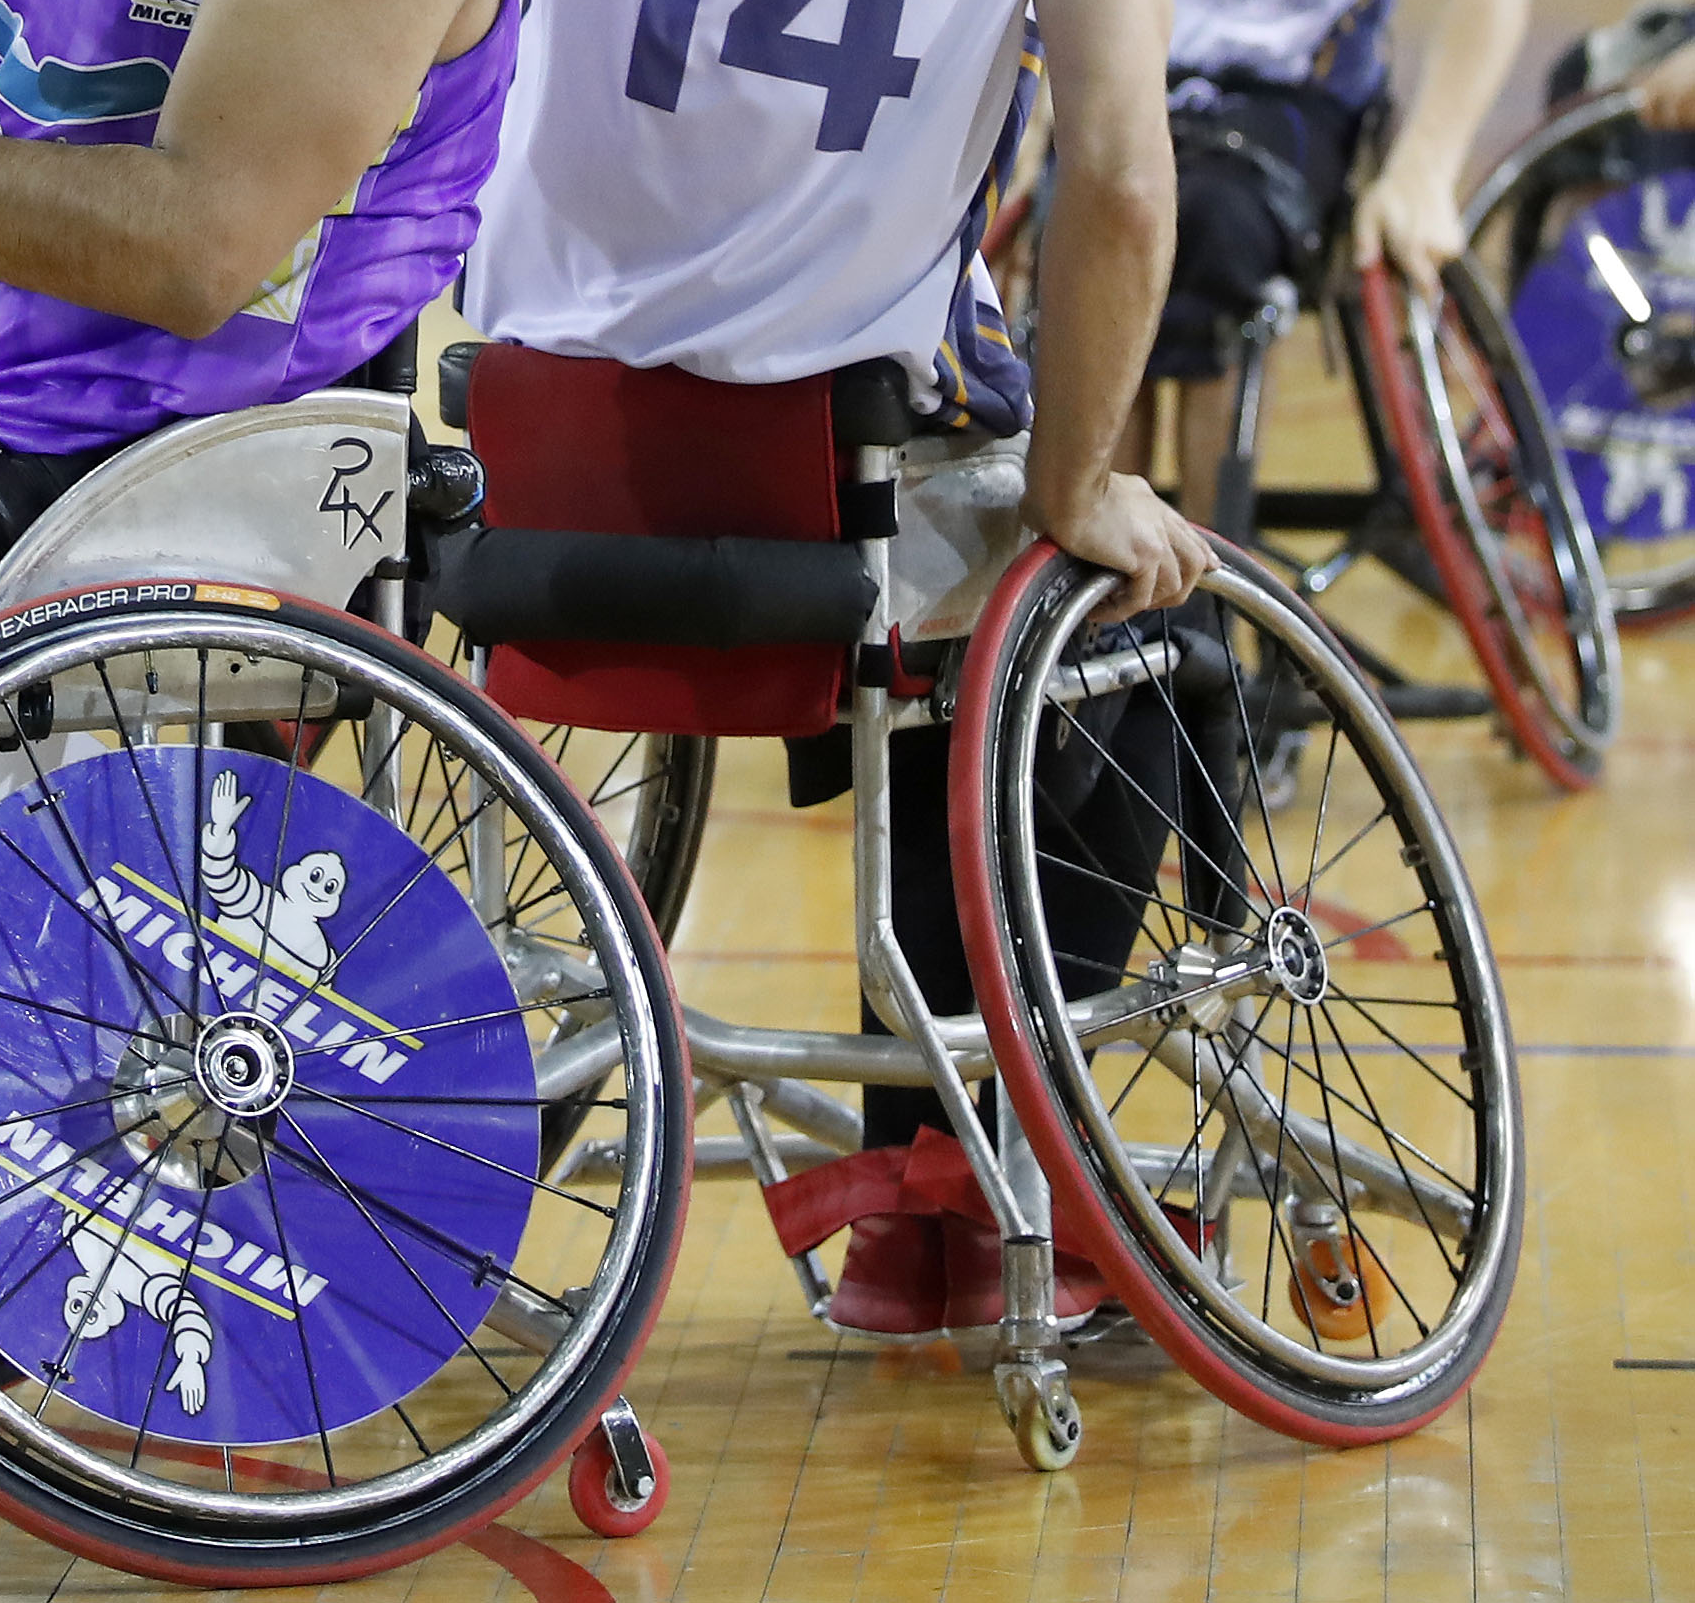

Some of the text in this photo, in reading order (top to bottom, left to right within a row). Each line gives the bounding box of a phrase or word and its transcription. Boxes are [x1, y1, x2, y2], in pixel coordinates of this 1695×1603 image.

[130, 3, 194, 28] MICH
[0, 587, 129, 639] EXERACER
[136, 584, 191, 603] PRO
[77, 874, 408, 1085] MICHELIN
